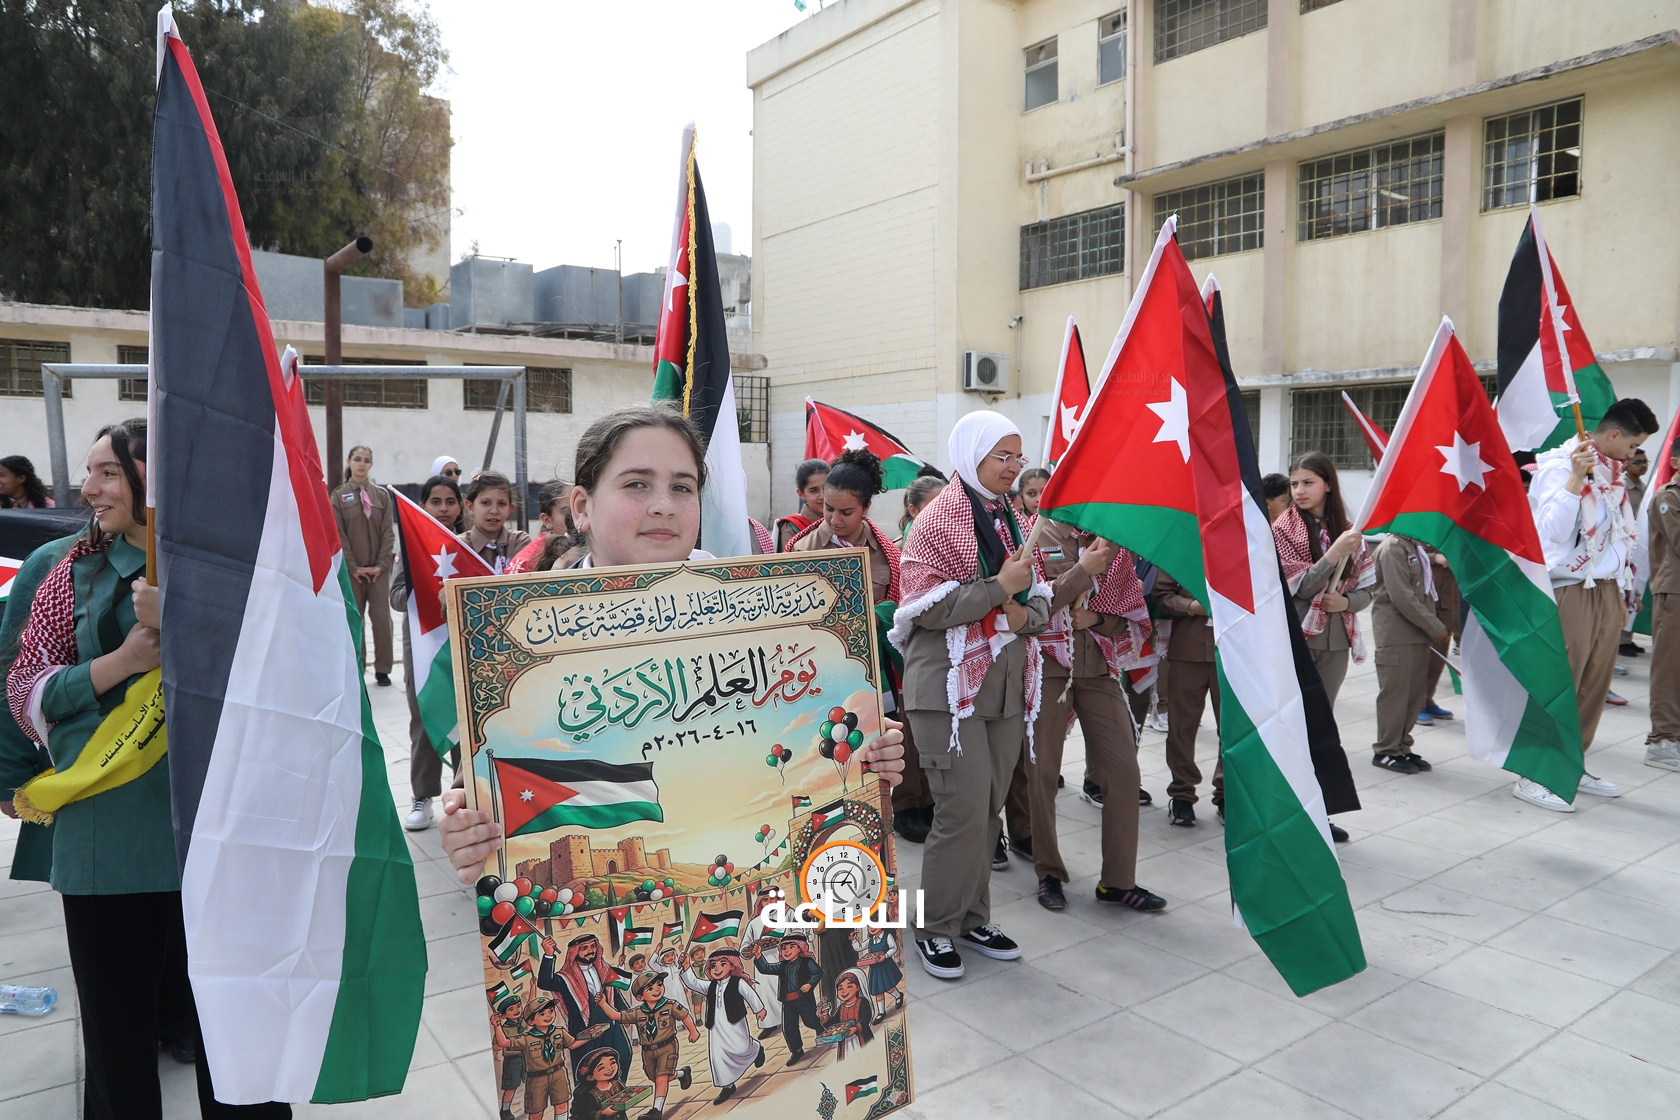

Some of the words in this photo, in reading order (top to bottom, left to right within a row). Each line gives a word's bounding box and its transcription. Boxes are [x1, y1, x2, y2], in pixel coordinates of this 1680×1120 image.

[590, 598, 645, 637] قصبة
[644, 594, 677, 634] لواء
[772, 580, 826, 619] مديرية
[672, 646, 768, 722] العلم
[751, 643, 822, 710] يوم
[557, 657, 688, 742] الأردني
[101, 739, 124, 768] للبنات
